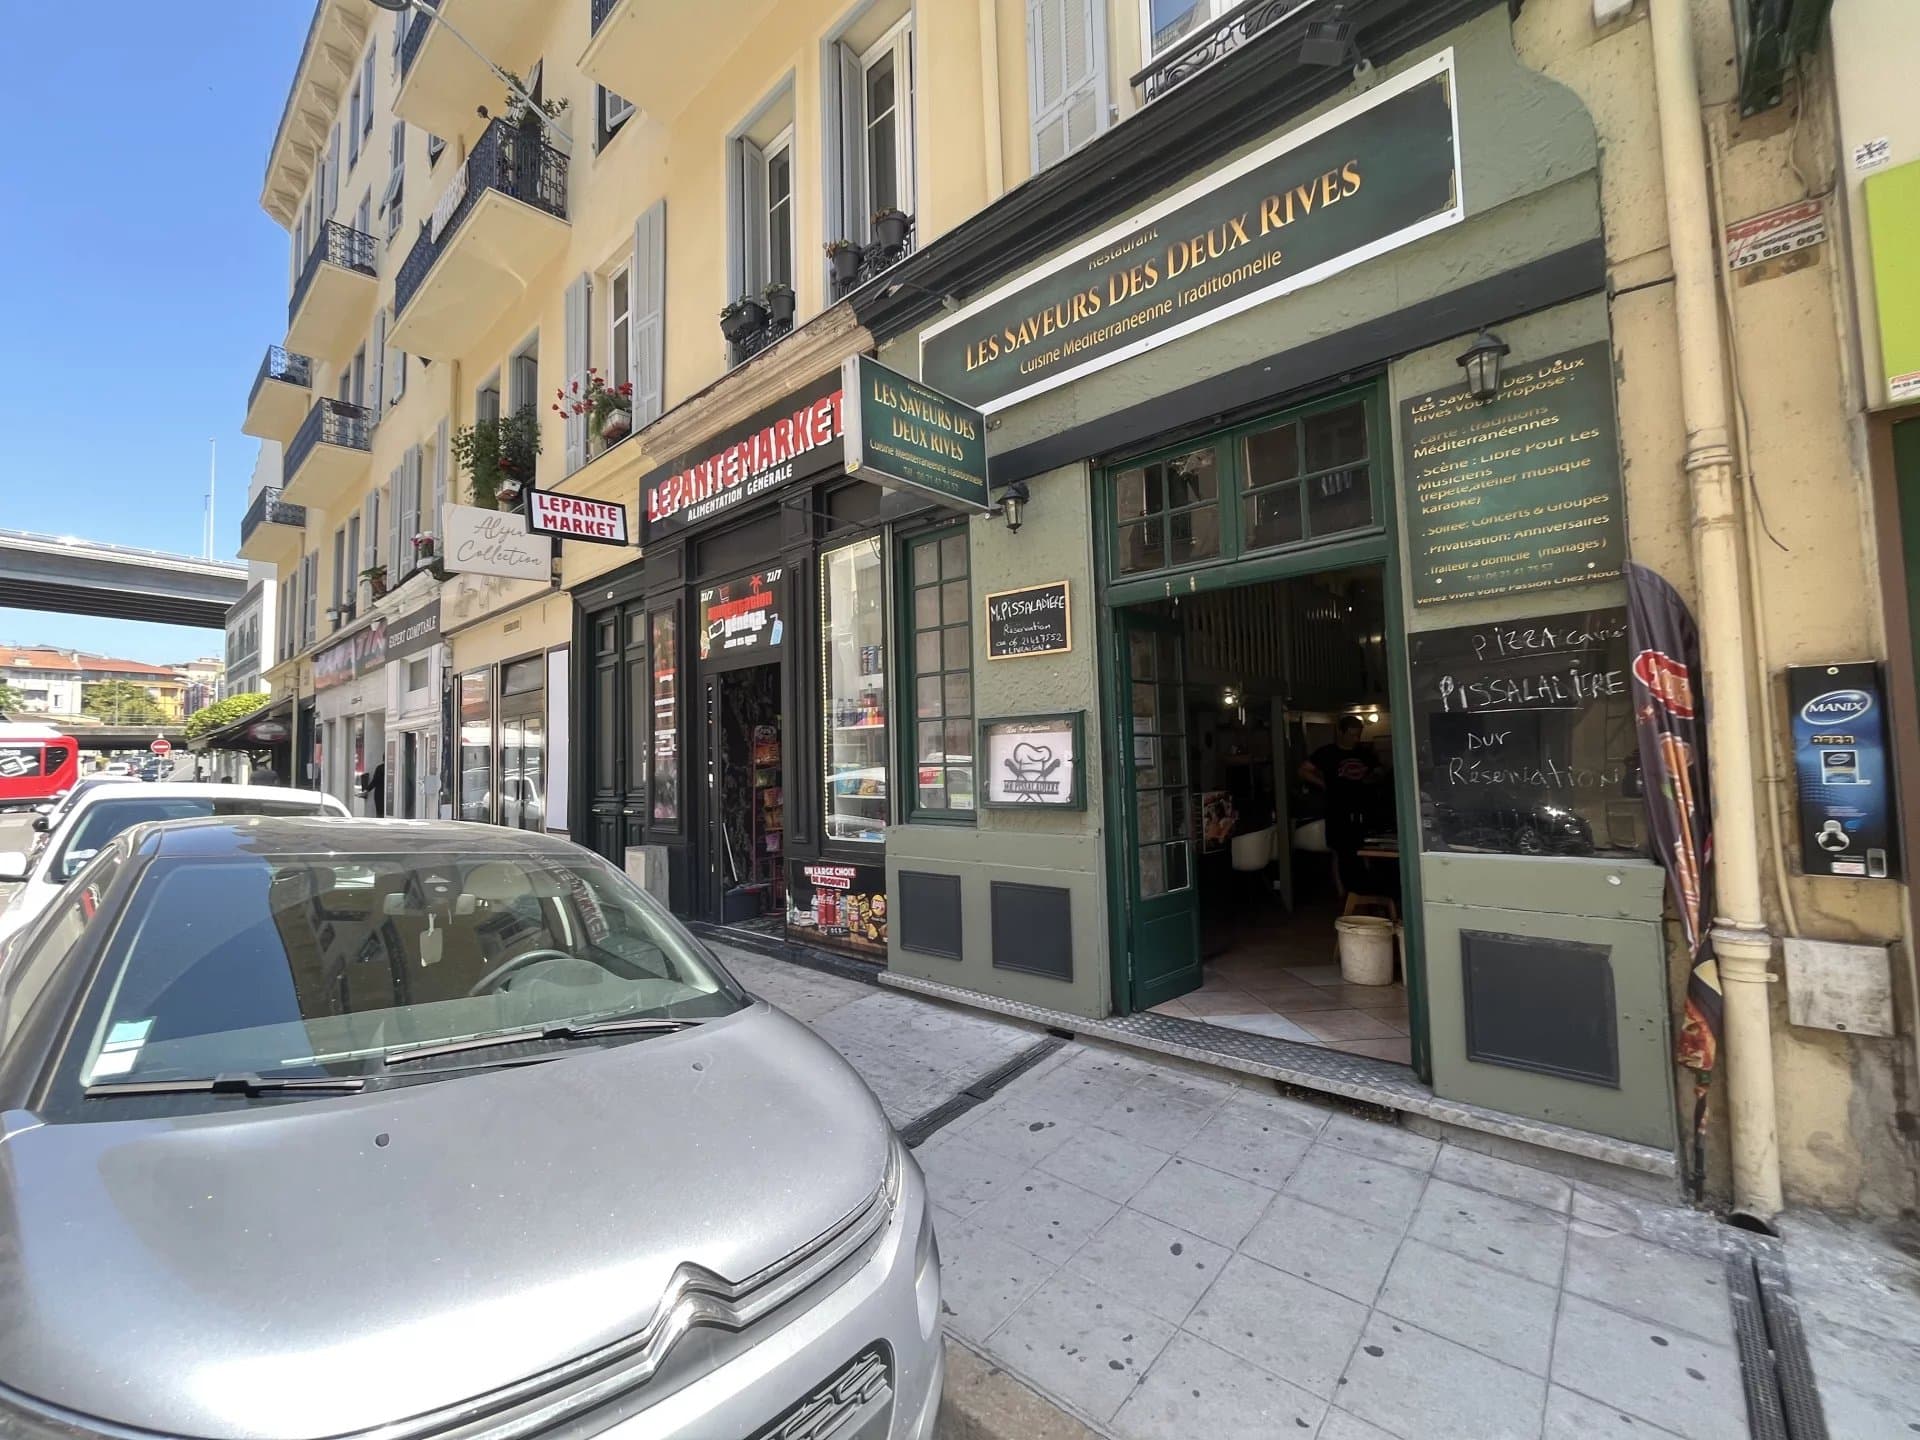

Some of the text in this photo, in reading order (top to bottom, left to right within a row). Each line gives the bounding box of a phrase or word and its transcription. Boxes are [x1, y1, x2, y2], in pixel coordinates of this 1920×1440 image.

[965, 159, 1362, 372] LES SAVEURS DES DEUX RIVES
[1088, 227, 1159, 270] Restaurant
[1020, 346, 1061, 376] Cuisine
[1177, 248, 1283, 310] Traditionnelle
[1411, 398, 1435, 415] Les
[1502, 374, 1534, 389] Des
[1538, 358, 1585, 378] Deux
[1413, 408, 1452, 425] Rives
[1496, 377, 1566, 402] Propose
[874, 377, 976, 441] LES SAVEURS DES
[892, 416, 964, 462] DEUX RIVES
[1413, 414, 1560, 459] Méditerranéennes
[1424, 427, 1601, 477] Scène Libre Pour Les
[647, 389, 845, 524] LEPANTEMARKET
[1521, 457, 1592, 481] musique
[687, 464, 794, 522] ALIMENTATION GÉNÉRALE
[1417, 467, 1494, 492] Musiciens
[538, 494, 618, 522] LEPANTE
[543, 513, 617, 538] MARKET
[1471, 508, 1531, 528] Concerts
[1533, 506, 1545, 516] &
[1546, 491, 1610, 513] Groupes
[1513, 513, 1610, 540] Anniversaires
[456, 539, 544, 568] Collection
[1480, 550, 1531, 567] domicile
[1509, 578, 1552, 591] Passion
[1587, 569, 1620, 580] Nous
[388, 615, 437, 649] EXPERT COMPTABLE
[1809, 701, 1865, 714] MANIX
[804, 866, 856, 878] UN LARGE CHOIX
